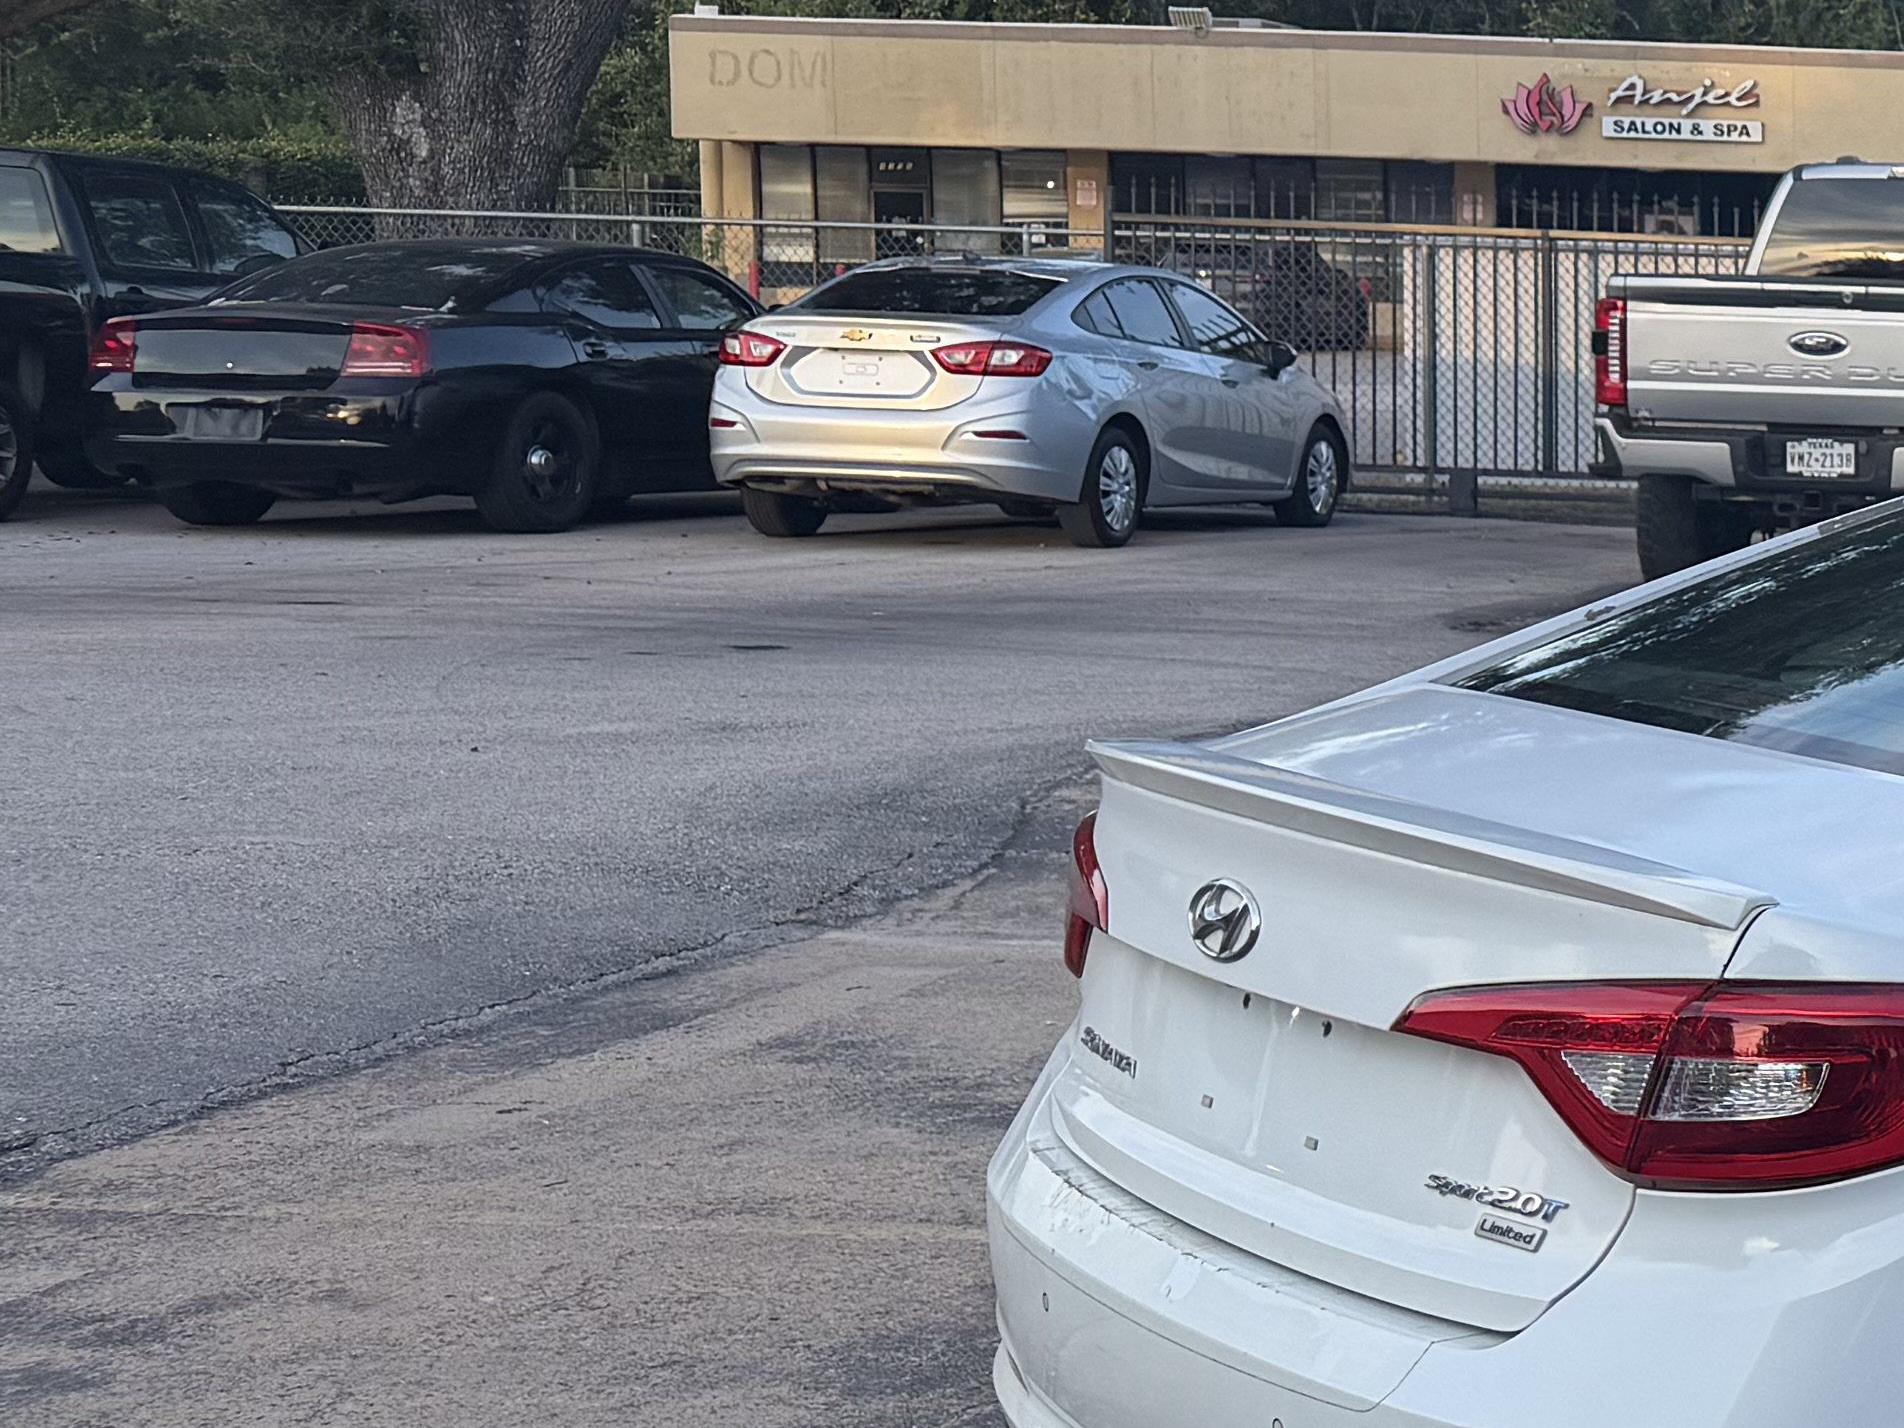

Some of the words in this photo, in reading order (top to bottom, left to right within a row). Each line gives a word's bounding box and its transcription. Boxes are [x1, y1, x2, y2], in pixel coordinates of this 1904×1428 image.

[1606, 75, 1758, 116] Anjel
[1613, 120, 1683, 137] SALON
[1690, 121, 1704, 137] &
[1712, 123, 1752, 139] SPA
[1649, 359, 1833, 381] SUPER
[1479, 1218, 1537, 1246] Limited
